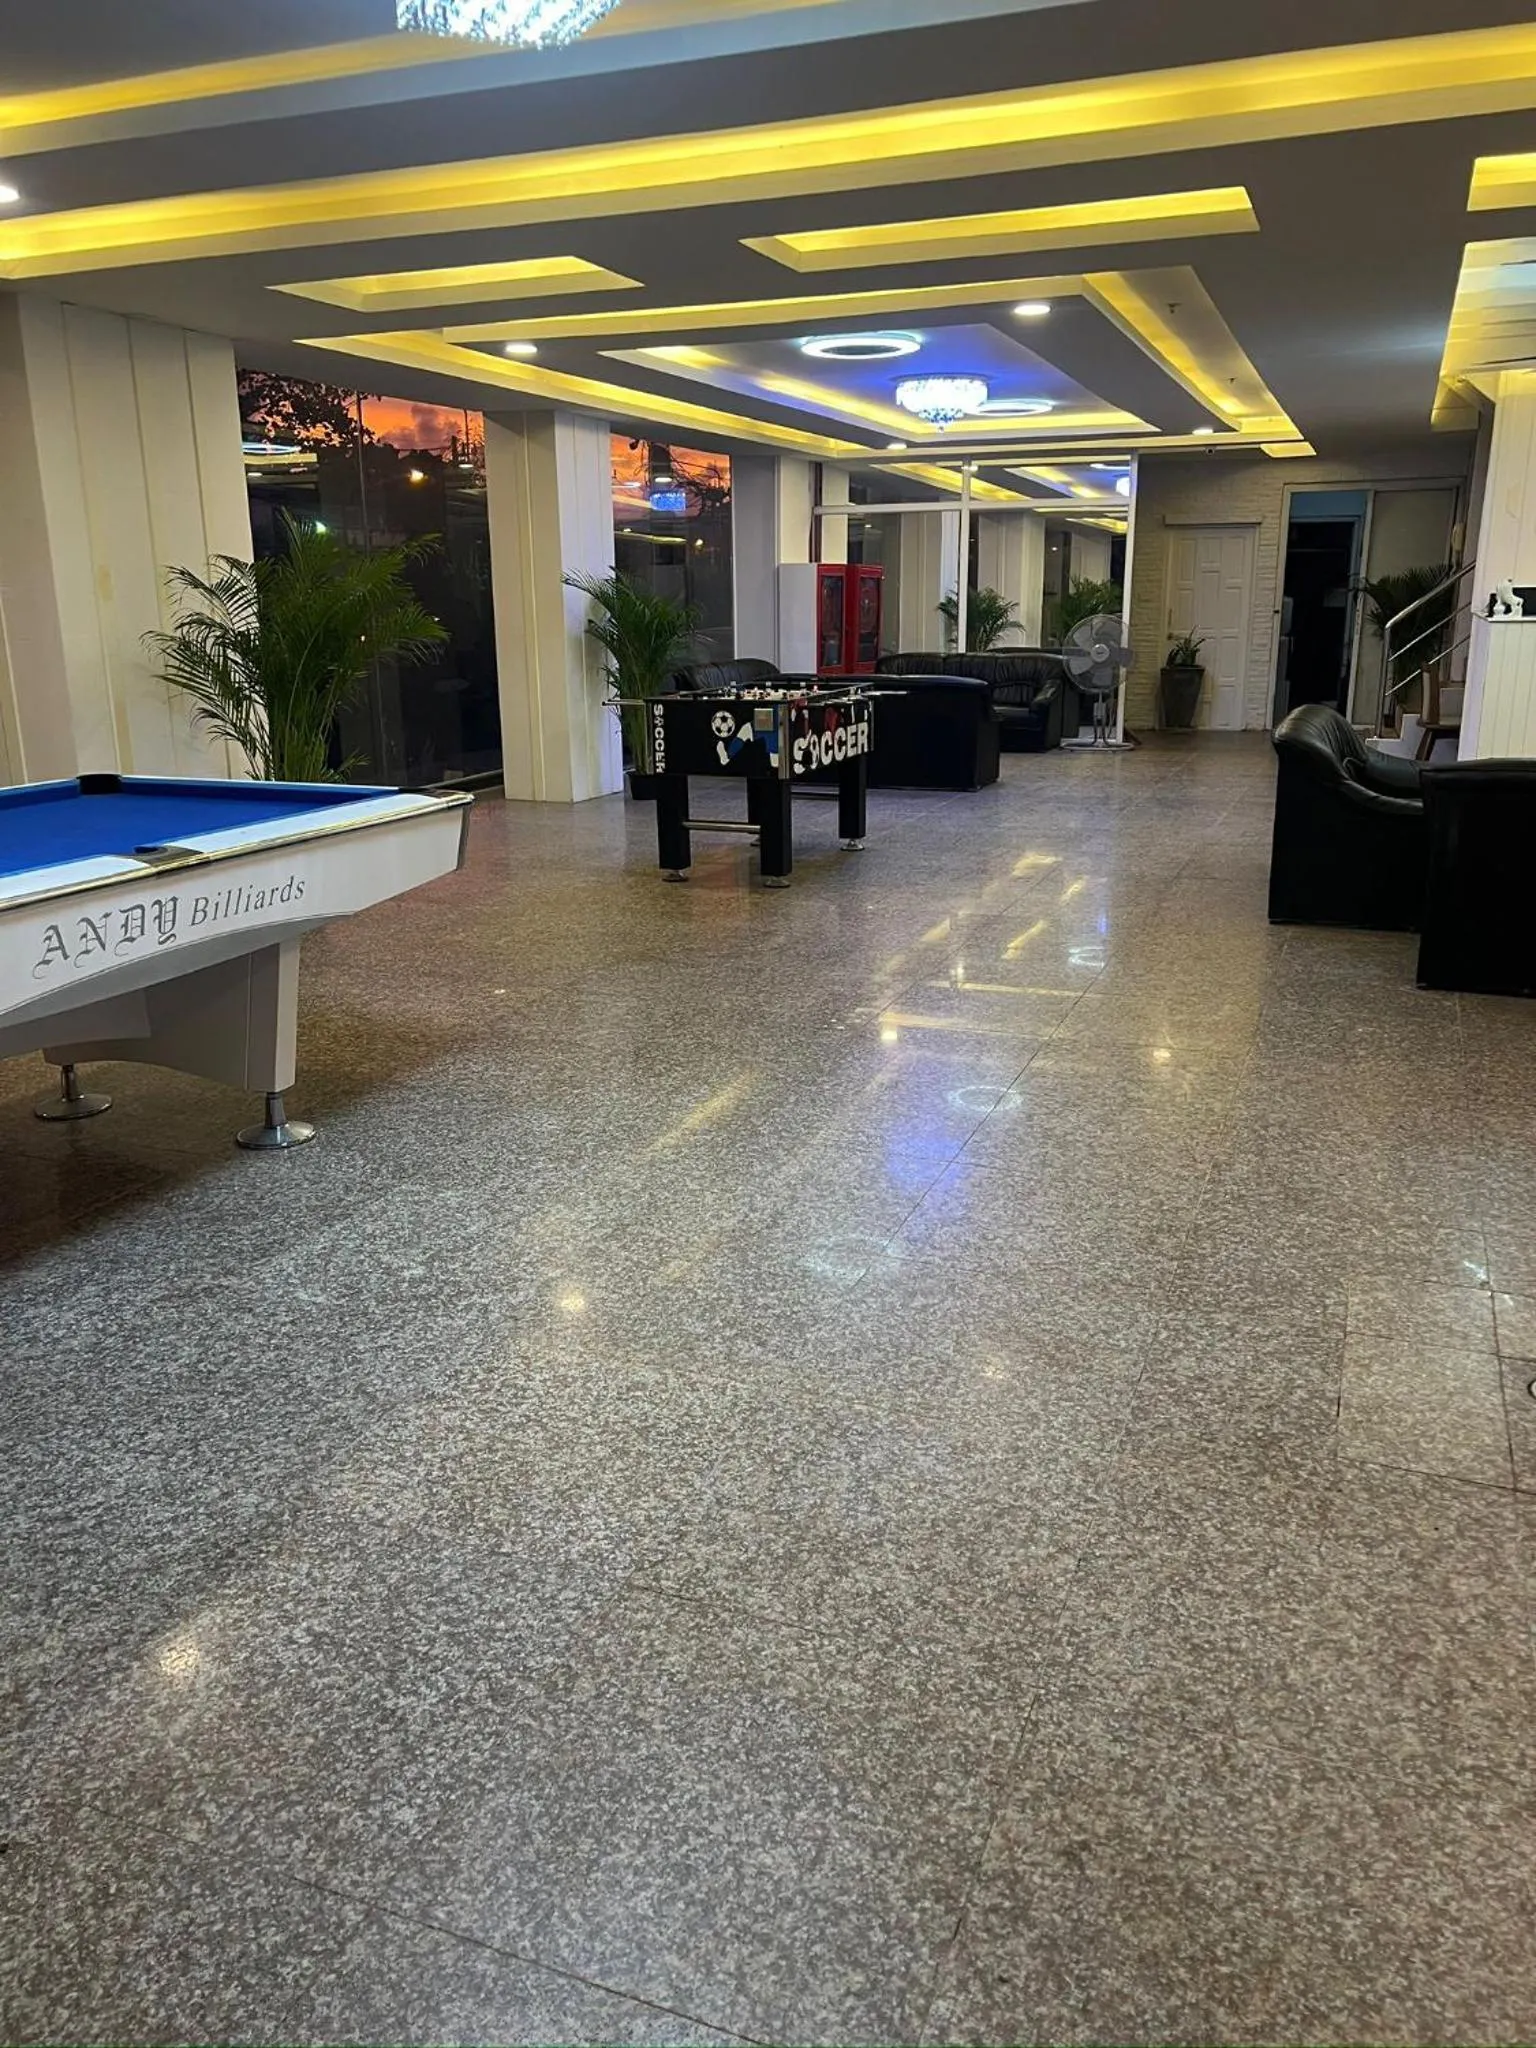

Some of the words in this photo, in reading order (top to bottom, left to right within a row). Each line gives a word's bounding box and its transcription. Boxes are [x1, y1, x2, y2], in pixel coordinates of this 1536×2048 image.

[653, 703, 666, 774] SOCCER
[793, 722, 868, 774] SOCCER
[31, 895, 181, 980] ANDY
[190, 875, 306, 927] Billiards
